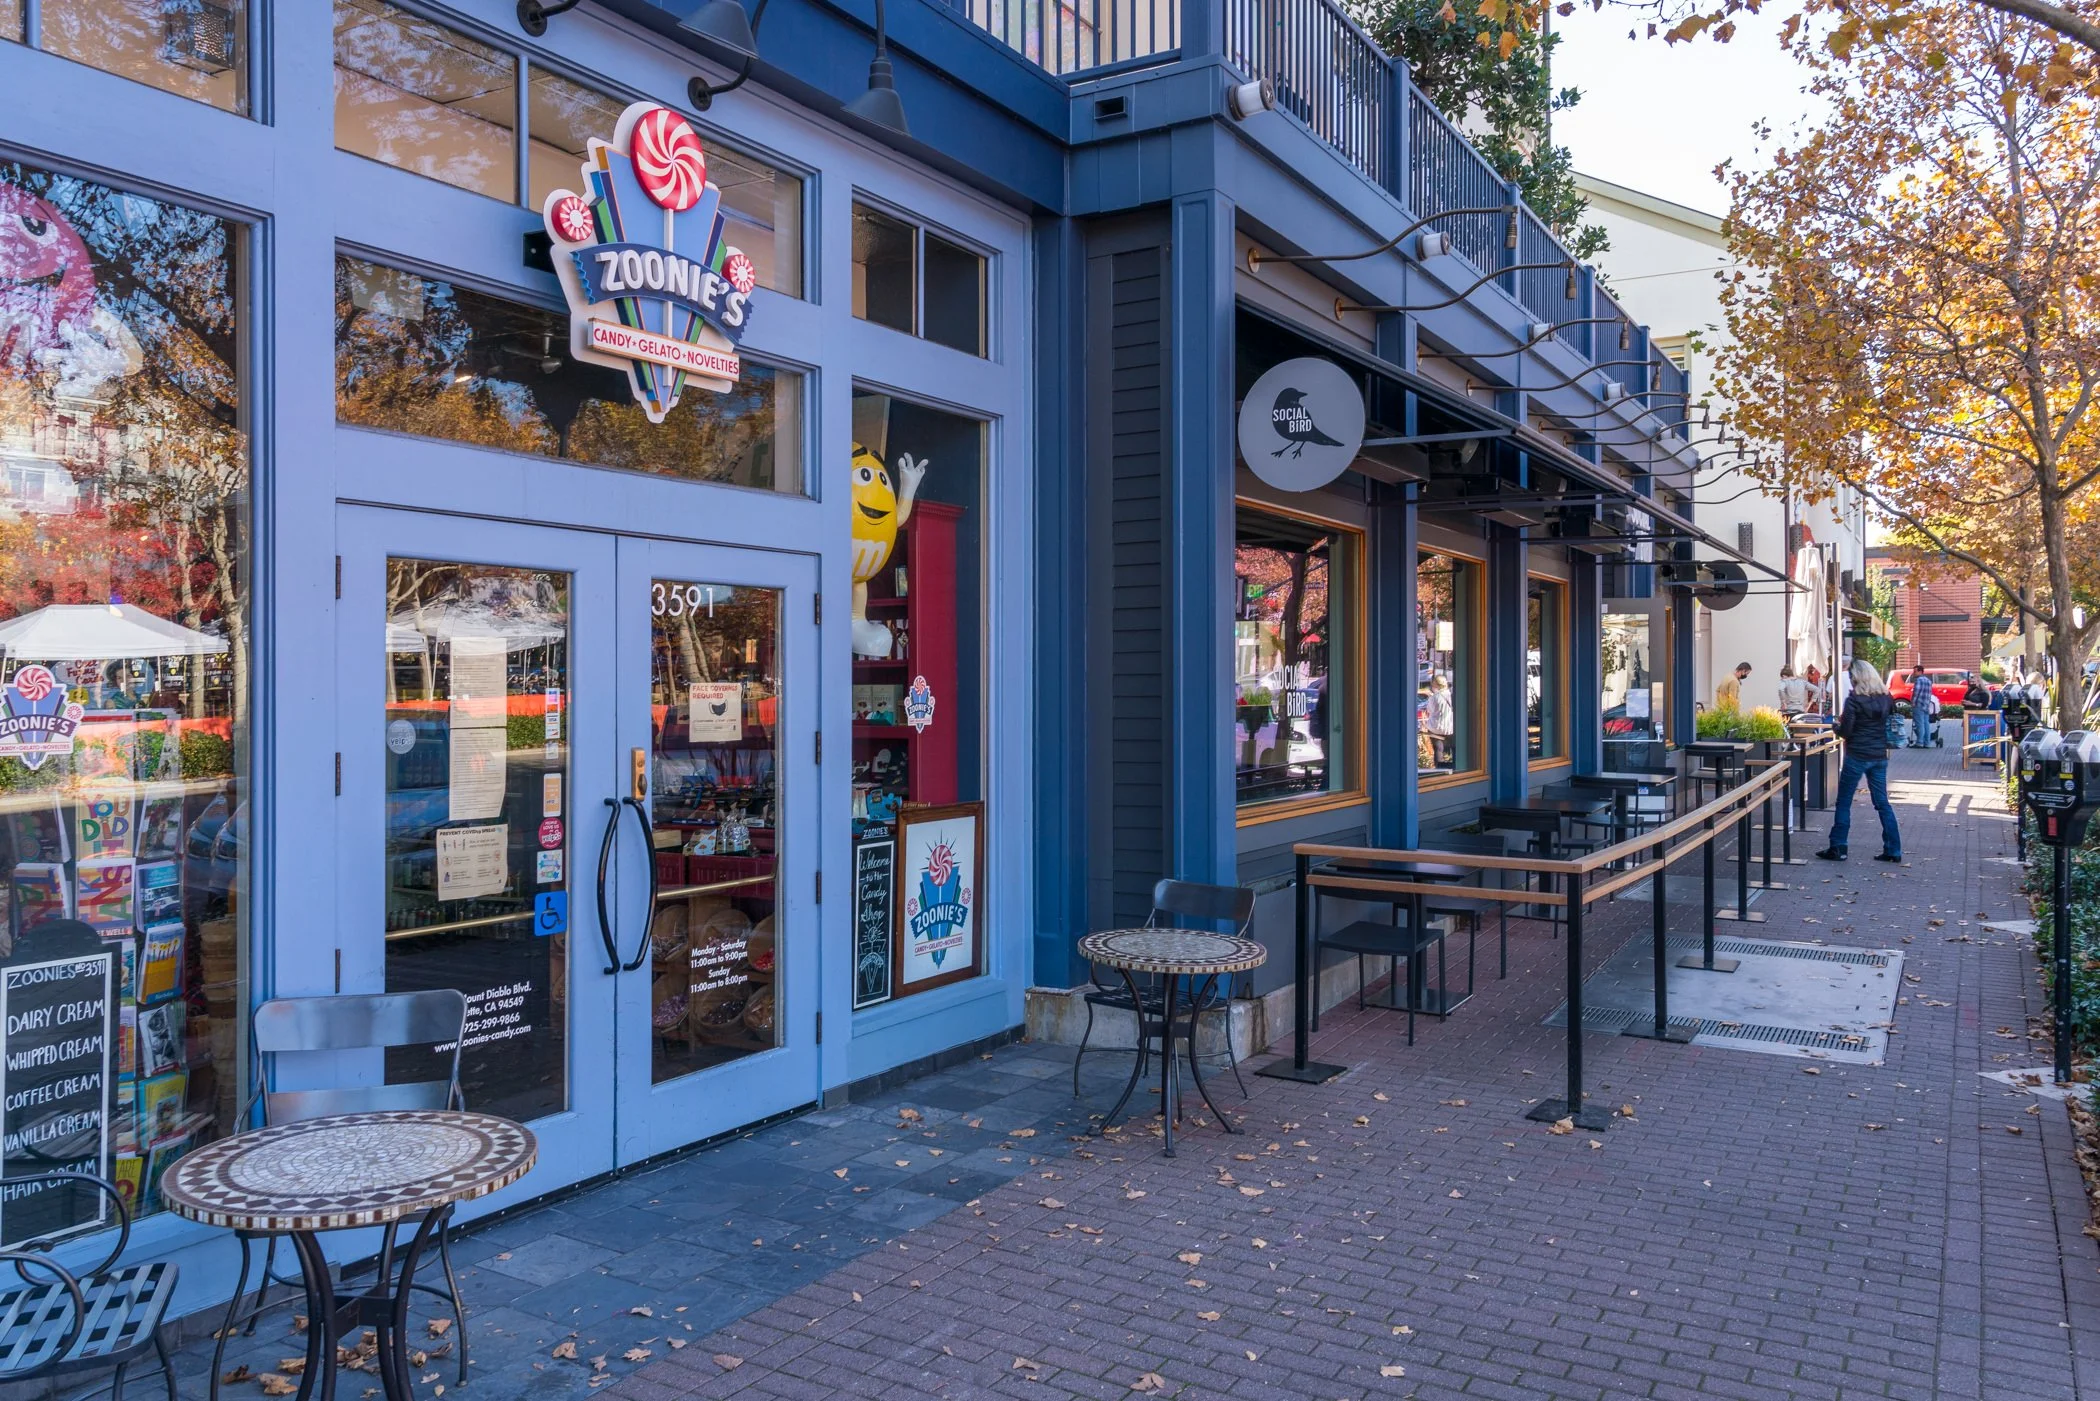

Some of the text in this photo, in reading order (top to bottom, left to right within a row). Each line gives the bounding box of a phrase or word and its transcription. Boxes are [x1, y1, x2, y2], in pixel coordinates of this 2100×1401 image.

[595, 250, 746, 328] ZOONIE'S
[593, 327, 739, 375] CANDY GELATO NOVELTIES
[1272, 406, 1309, 422] SOCIAL
[651, 583, 714, 618] 3591
[909, 703, 931, 714] ZOONIE'S
[0, 716, 71, 735] ZOONIE'S
[81, 816, 129, 842] DID
[859, 850, 890, 871] Welcome
[866, 871, 883, 882] to the
[861, 884, 888, 905] Candy
[861, 903, 886, 922] Shop
[915, 904, 964, 933] ZOONIE'S
[692, 945, 717, 957] Monday
[720, 939, 747, 951] Saturday
[718, 955, 724, 963] to
[8, 964, 76, 990] ZOONIES
[84, 960, 106, 977] 3591
[708, 966, 731, 978] Sunday
[464, 981, 532, 1003] ount Diablo Blvd.
[718, 979, 724, 987] to
[484, 1001, 497, 1013] CA
[498, 996, 524, 1010] 94549
[8, 999, 105, 1036] DAIRY CREAM
[6, 1035, 103, 1072] WHIPPED CREAM
[6, 1072, 101, 1112] COFFEE CREAM
[4, 1110, 102, 1152] VANILLA CREAM
